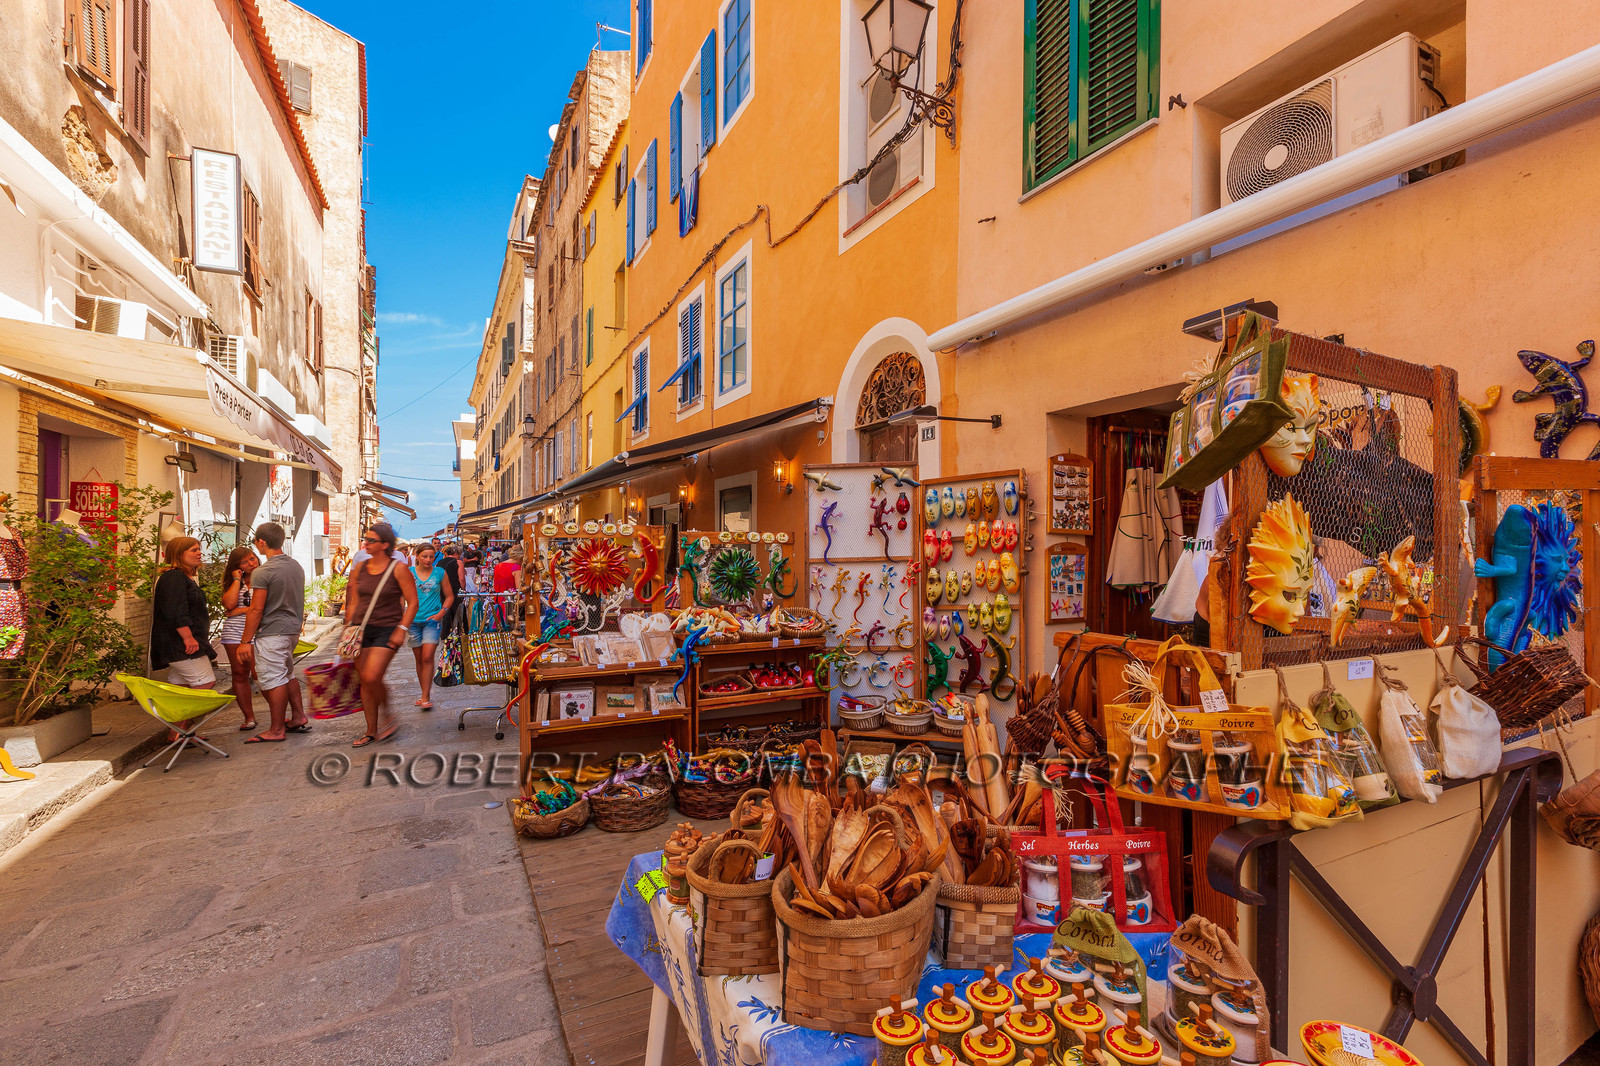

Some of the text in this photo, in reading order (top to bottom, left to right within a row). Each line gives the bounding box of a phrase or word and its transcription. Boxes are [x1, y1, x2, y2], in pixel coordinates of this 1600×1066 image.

[203, 159, 231, 259] RESTAURANT
[233, 396, 252, 421] Porter
[76, 484, 112, 492] SOLDES
[1121, 713, 1137, 722] Sel
[1219, 719, 1255, 728] Poivre
[1020, 839, 1151, 851] Sel Herbes Poivre
